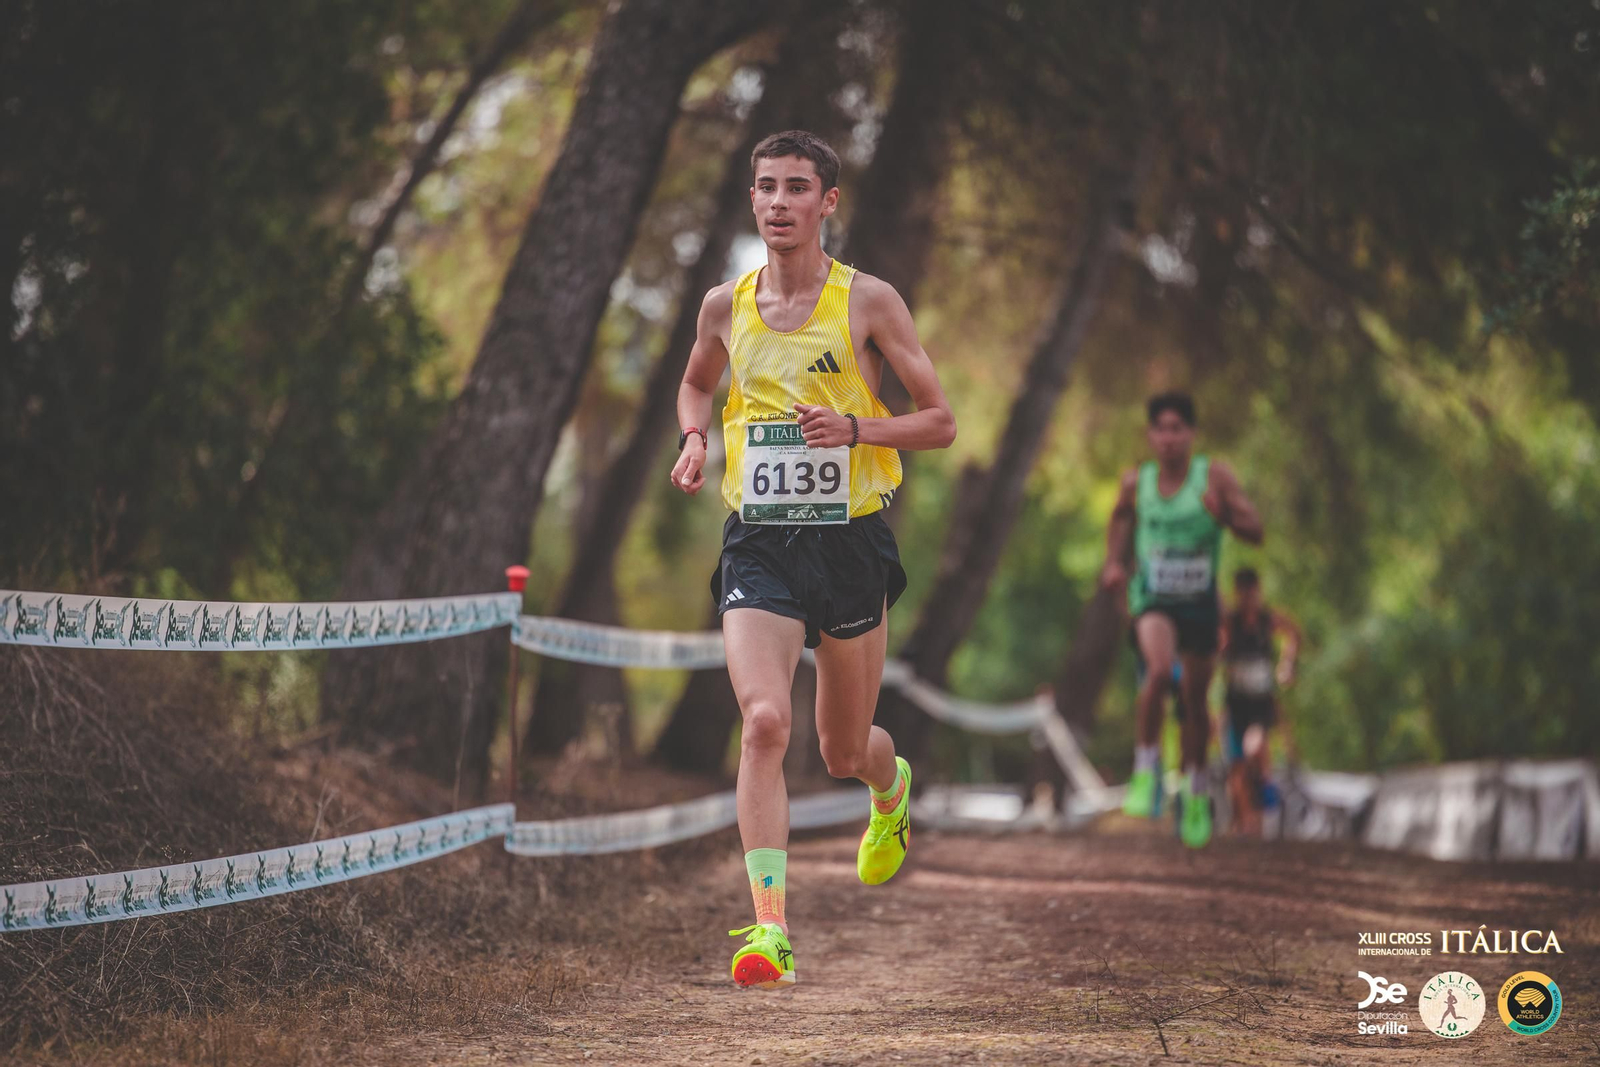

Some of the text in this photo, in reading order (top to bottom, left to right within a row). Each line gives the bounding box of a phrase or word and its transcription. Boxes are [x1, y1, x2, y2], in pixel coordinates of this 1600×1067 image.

[750, 411, 801, 422] C.A. KILÓME
[753, 462, 841, 495] 6139
